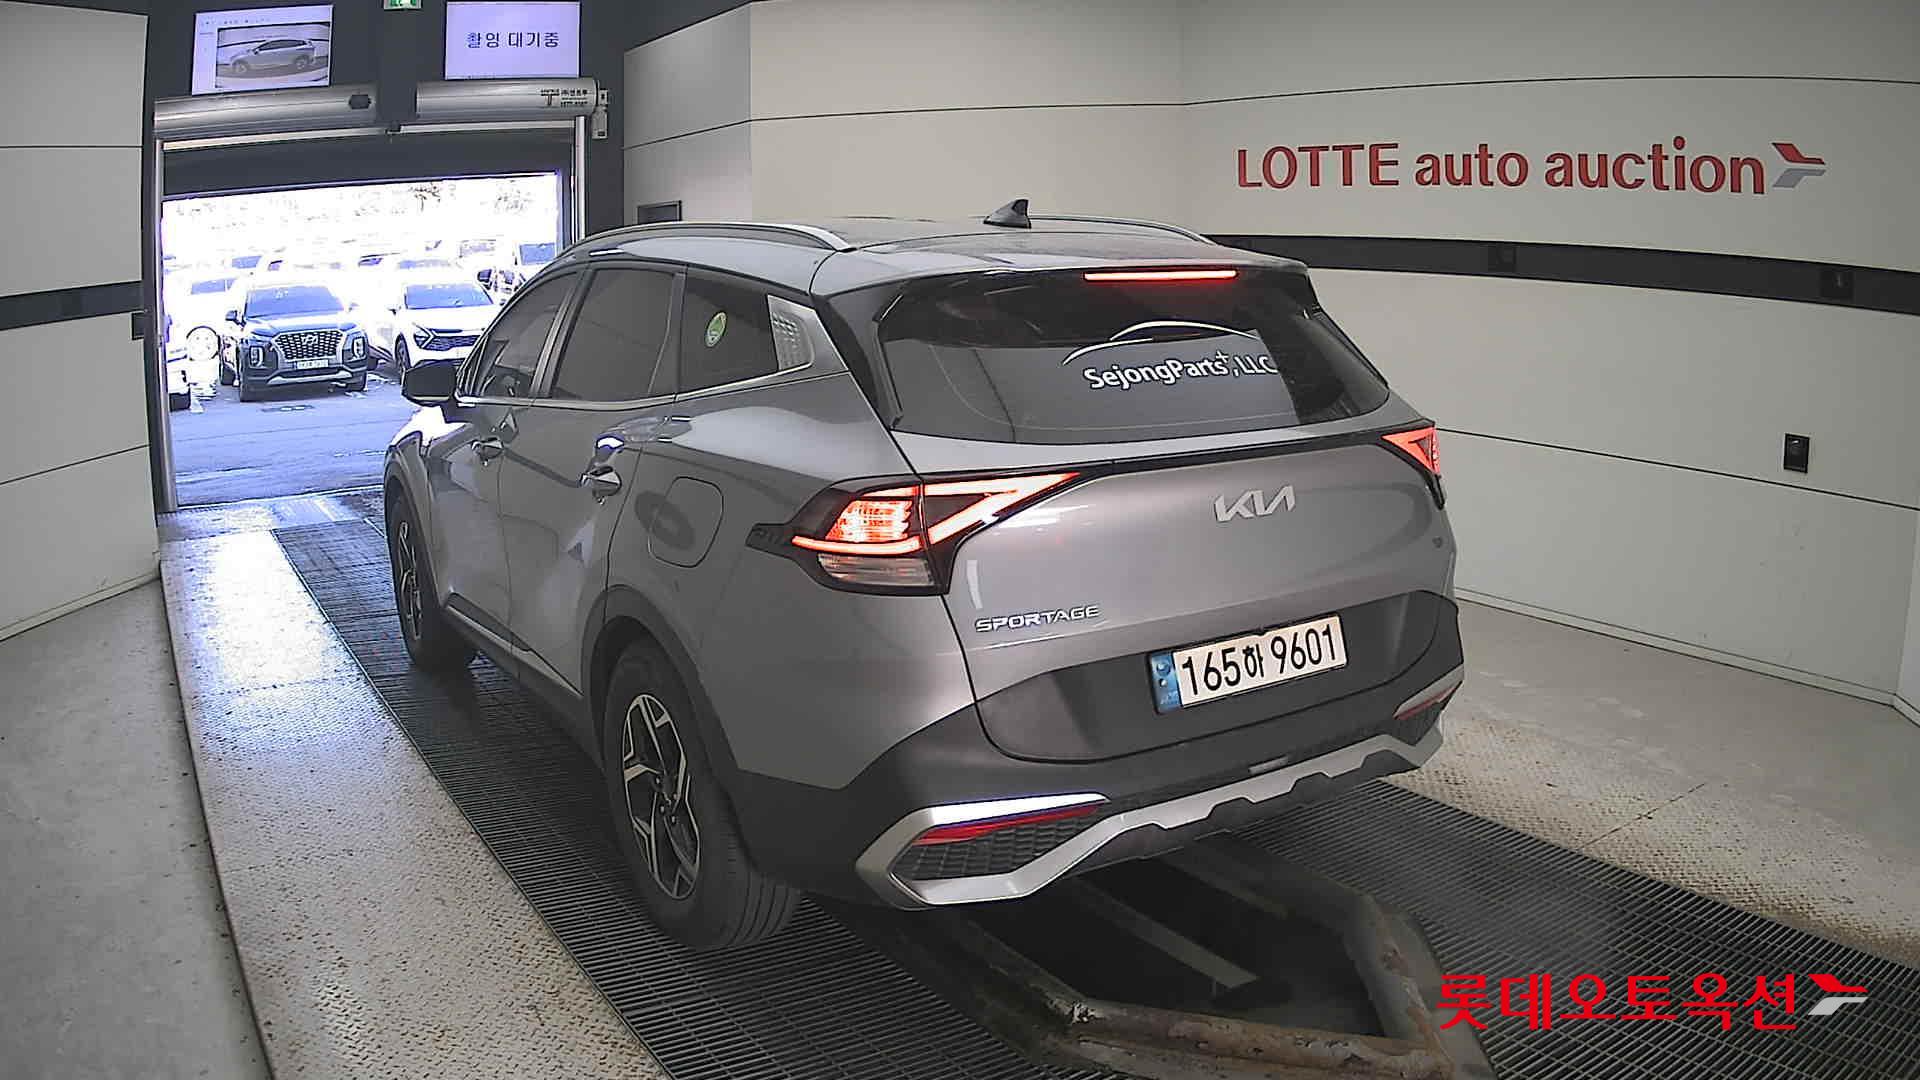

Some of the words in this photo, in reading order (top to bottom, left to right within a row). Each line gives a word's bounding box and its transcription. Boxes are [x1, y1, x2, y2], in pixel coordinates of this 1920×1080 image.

[508, 32, 560, 48] 대기중
[1236, 143, 1400, 189] LOTTE
[1414, 143, 1530, 188] auto
[1544, 135, 1766, 194] auction
[1213, 484, 1296, 523] KIA
[975, 604, 1100, 633] SPORTAGE
